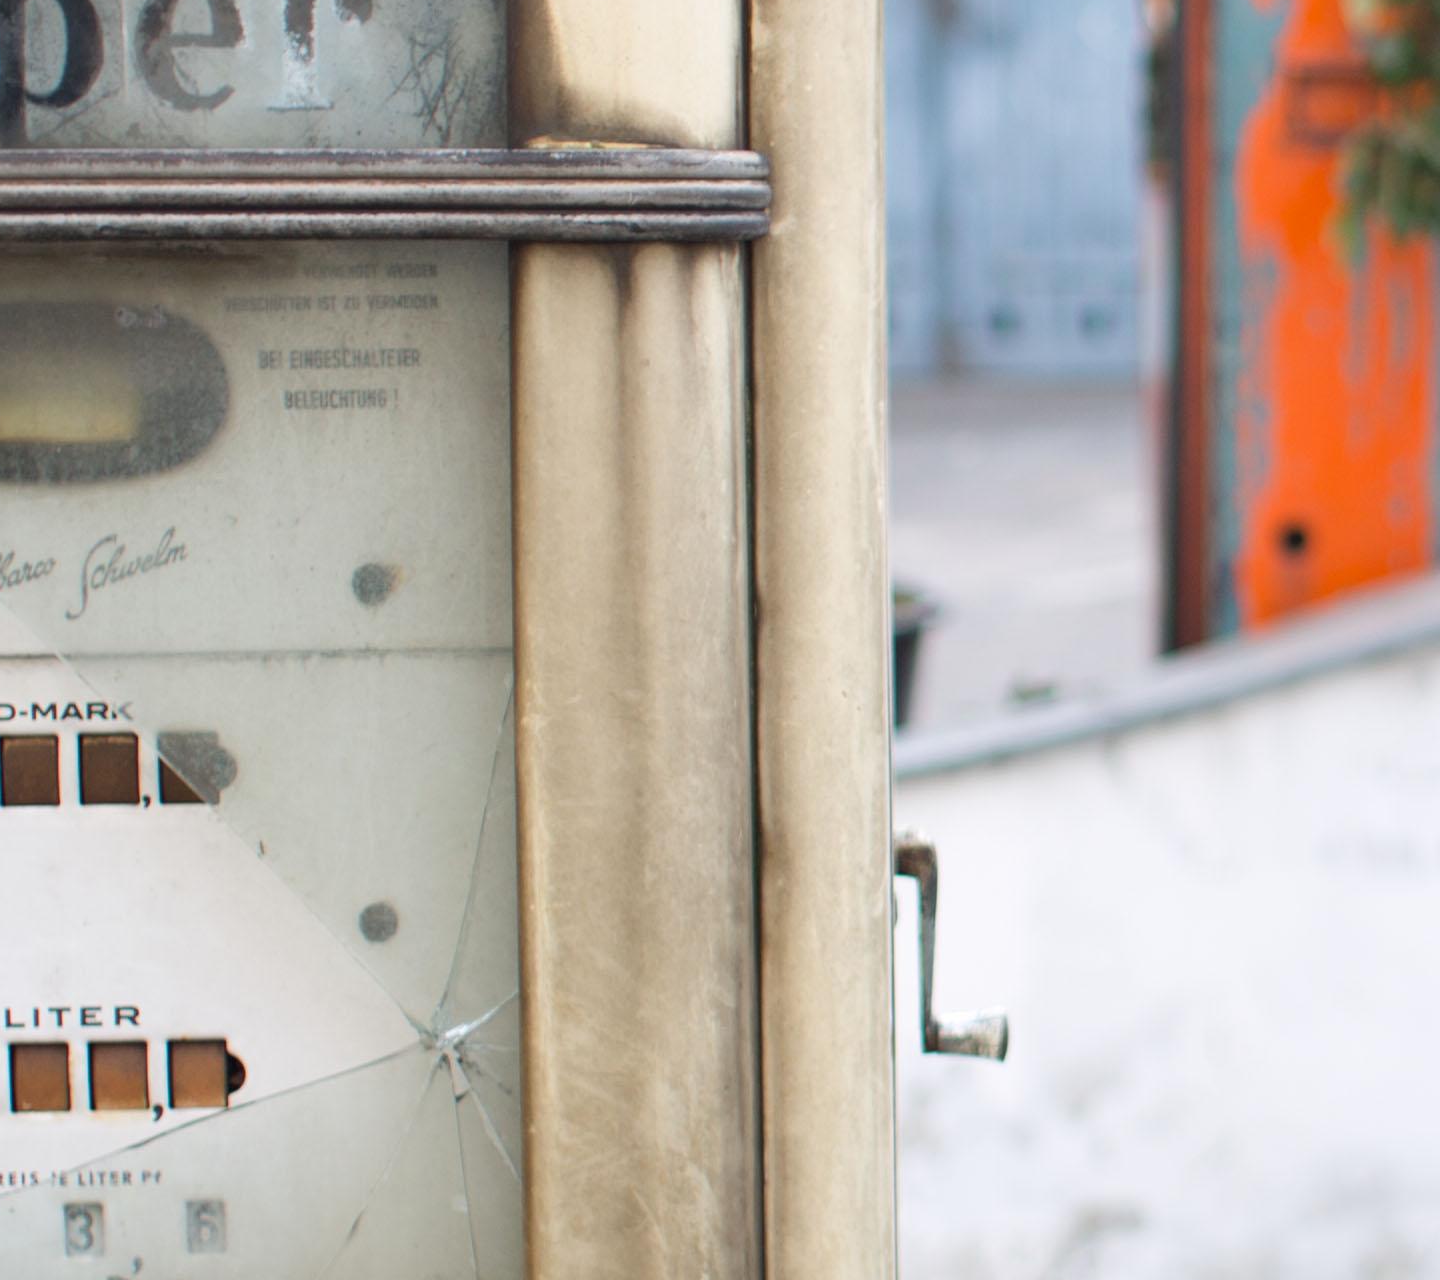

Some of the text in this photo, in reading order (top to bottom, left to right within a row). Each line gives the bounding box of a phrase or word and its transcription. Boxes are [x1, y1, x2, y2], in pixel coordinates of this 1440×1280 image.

[257, 348, 283, 369] BEI
[5, 1005, 141, 1028] LITER
[77, 1169, 133, 1187] LITER
